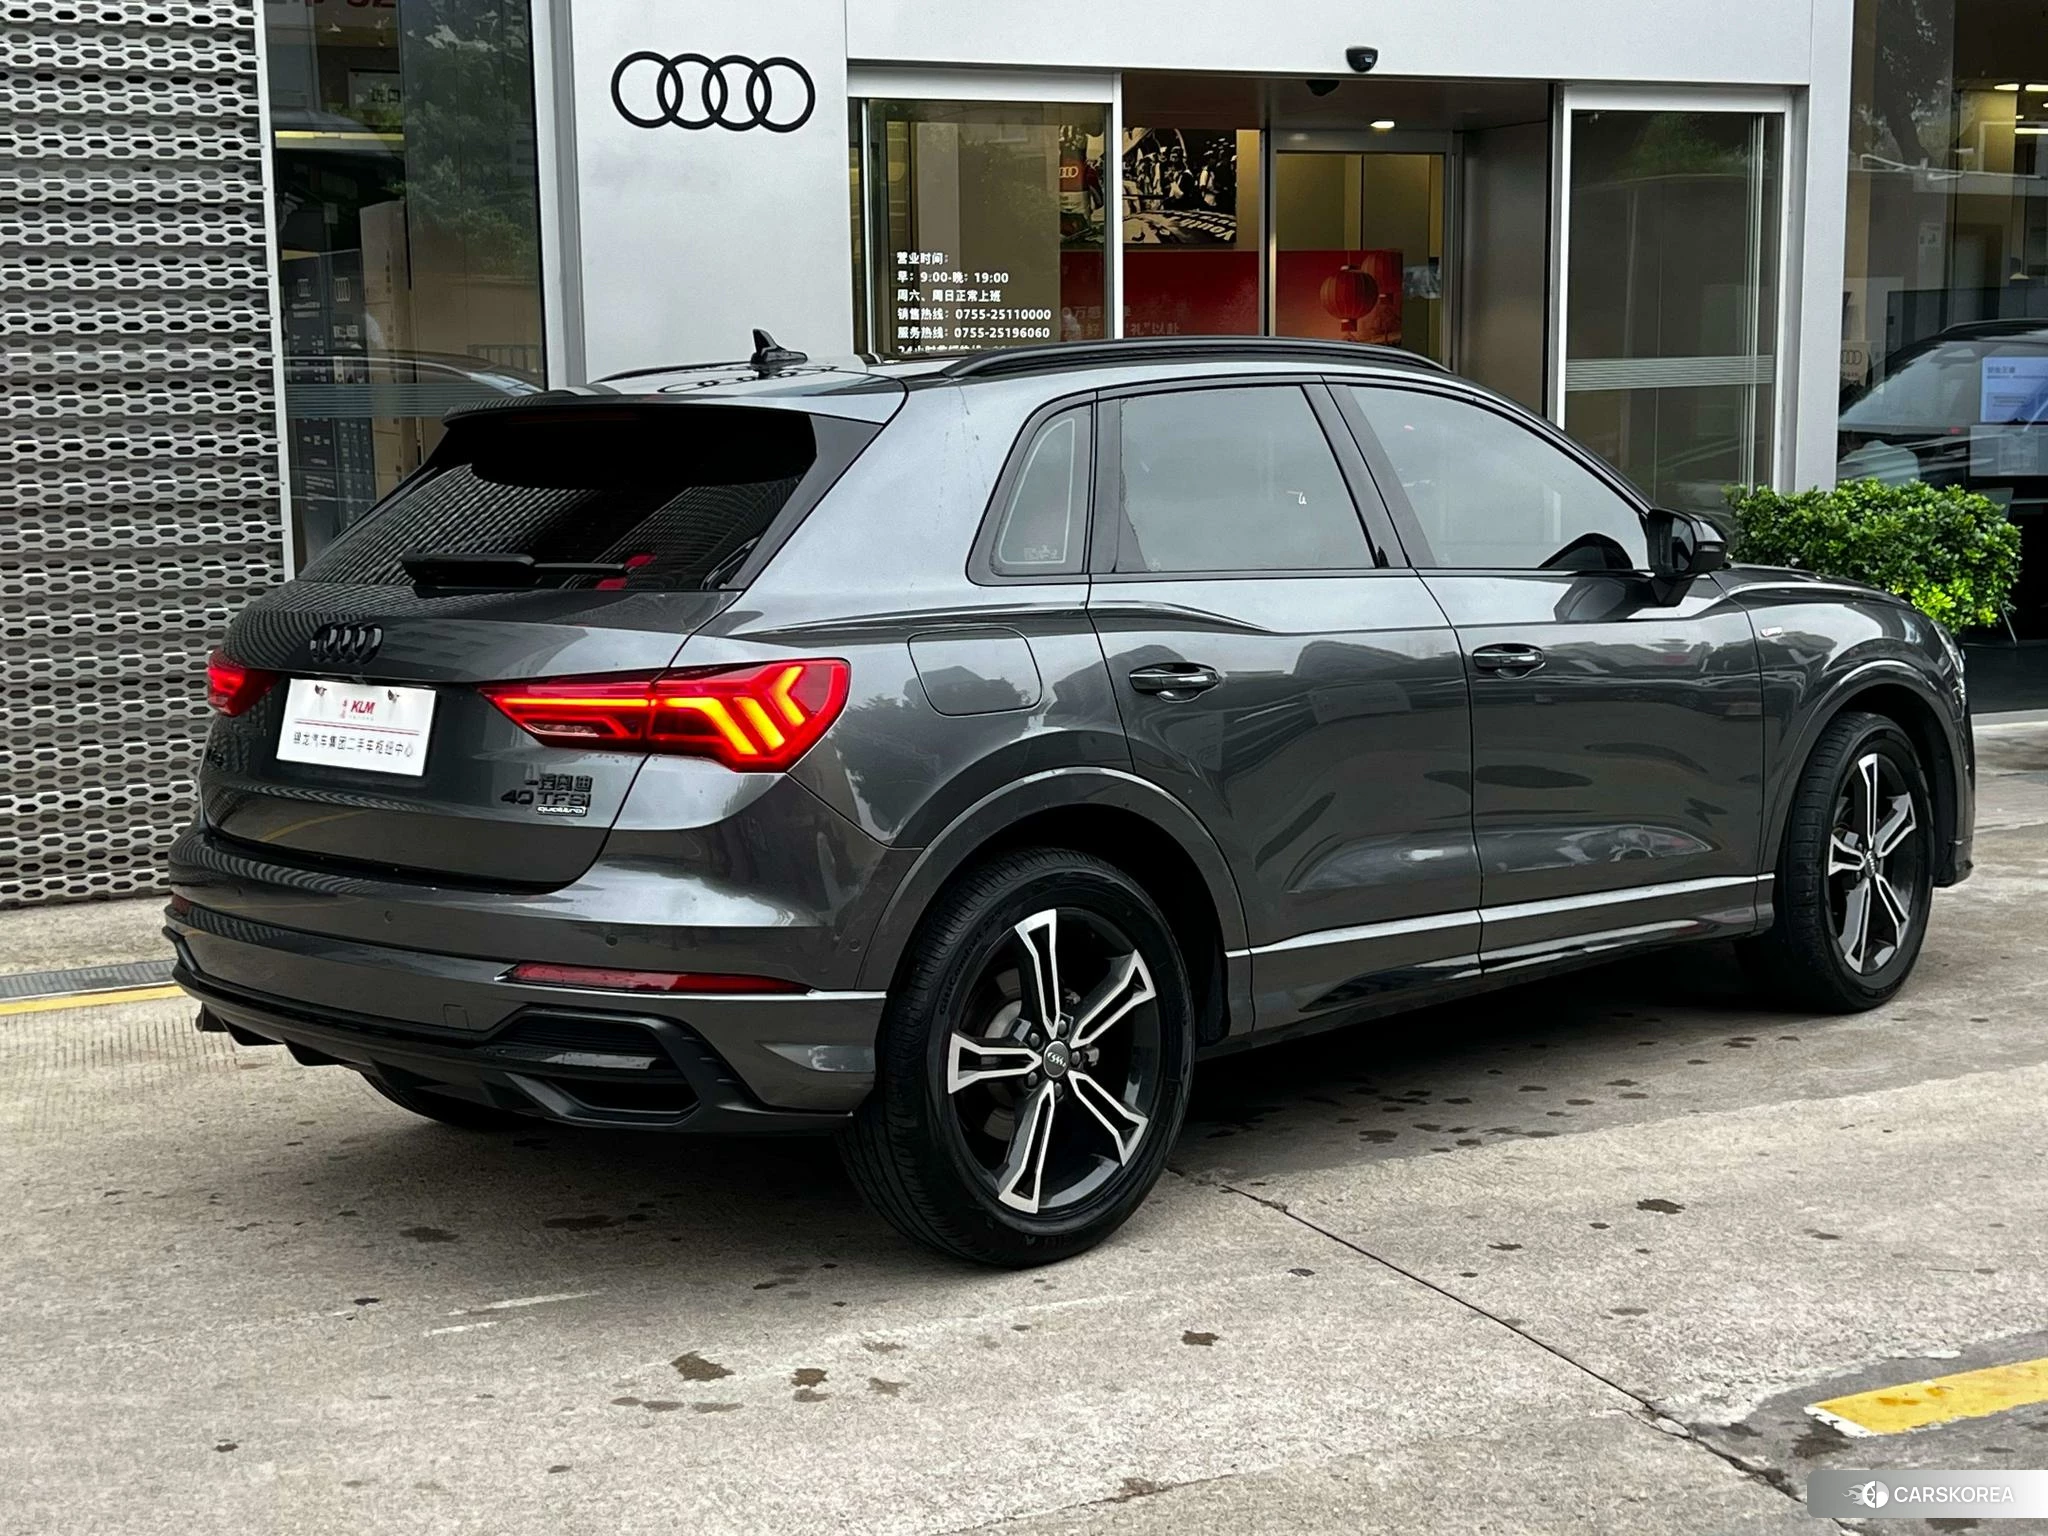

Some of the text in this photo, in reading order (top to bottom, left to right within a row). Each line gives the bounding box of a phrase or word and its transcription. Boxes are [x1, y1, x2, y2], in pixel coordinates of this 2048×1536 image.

[897, 288, 1001, 302] 周六、周日正常上班
[350, 699, 377, 715] KLM
[500, 789, 534, 805] 40
